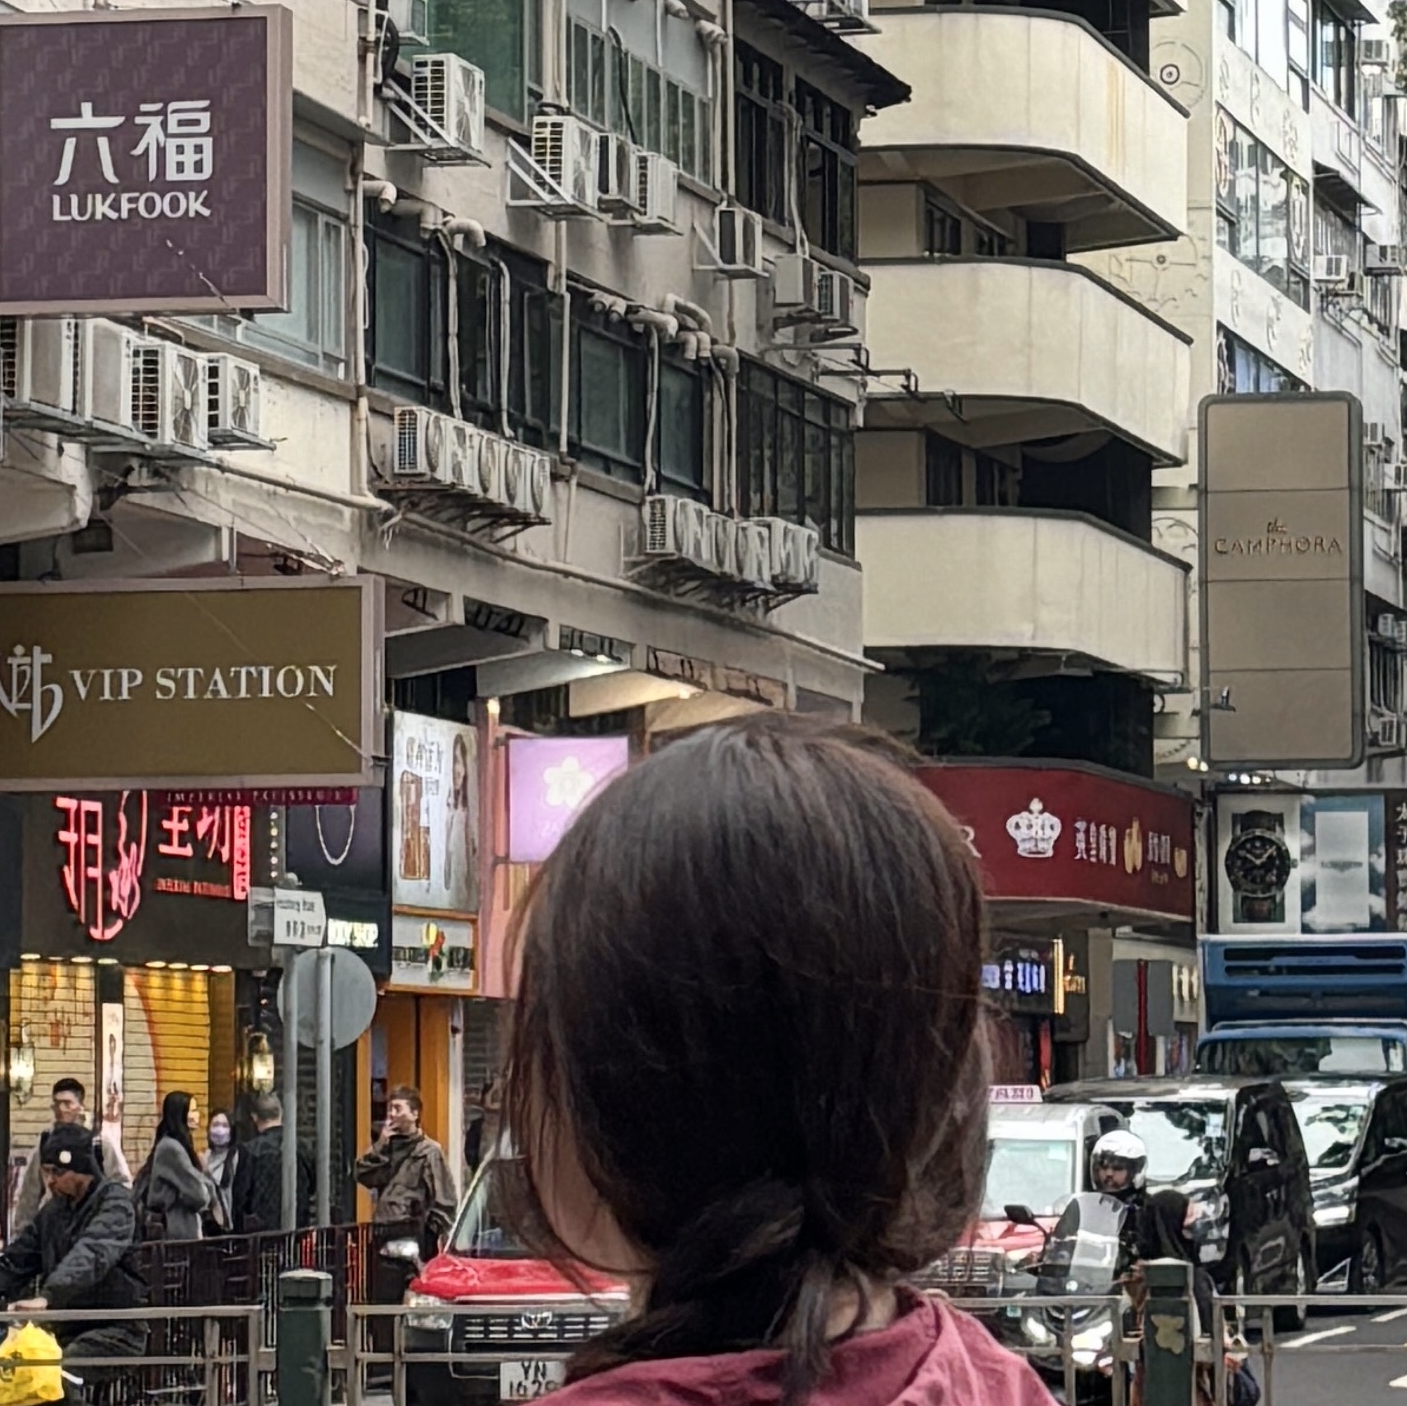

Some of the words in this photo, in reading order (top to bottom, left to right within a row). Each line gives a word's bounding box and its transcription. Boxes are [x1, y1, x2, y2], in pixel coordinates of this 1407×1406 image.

[49, 100, 213, 186] 六福
[52, 189, 211, 221] LUKFOOK
[1214, 535, 1342, 555] CAMPHORA
[68, 667, 143, 701] VIP
[155, 664, 337, 700] STATION
